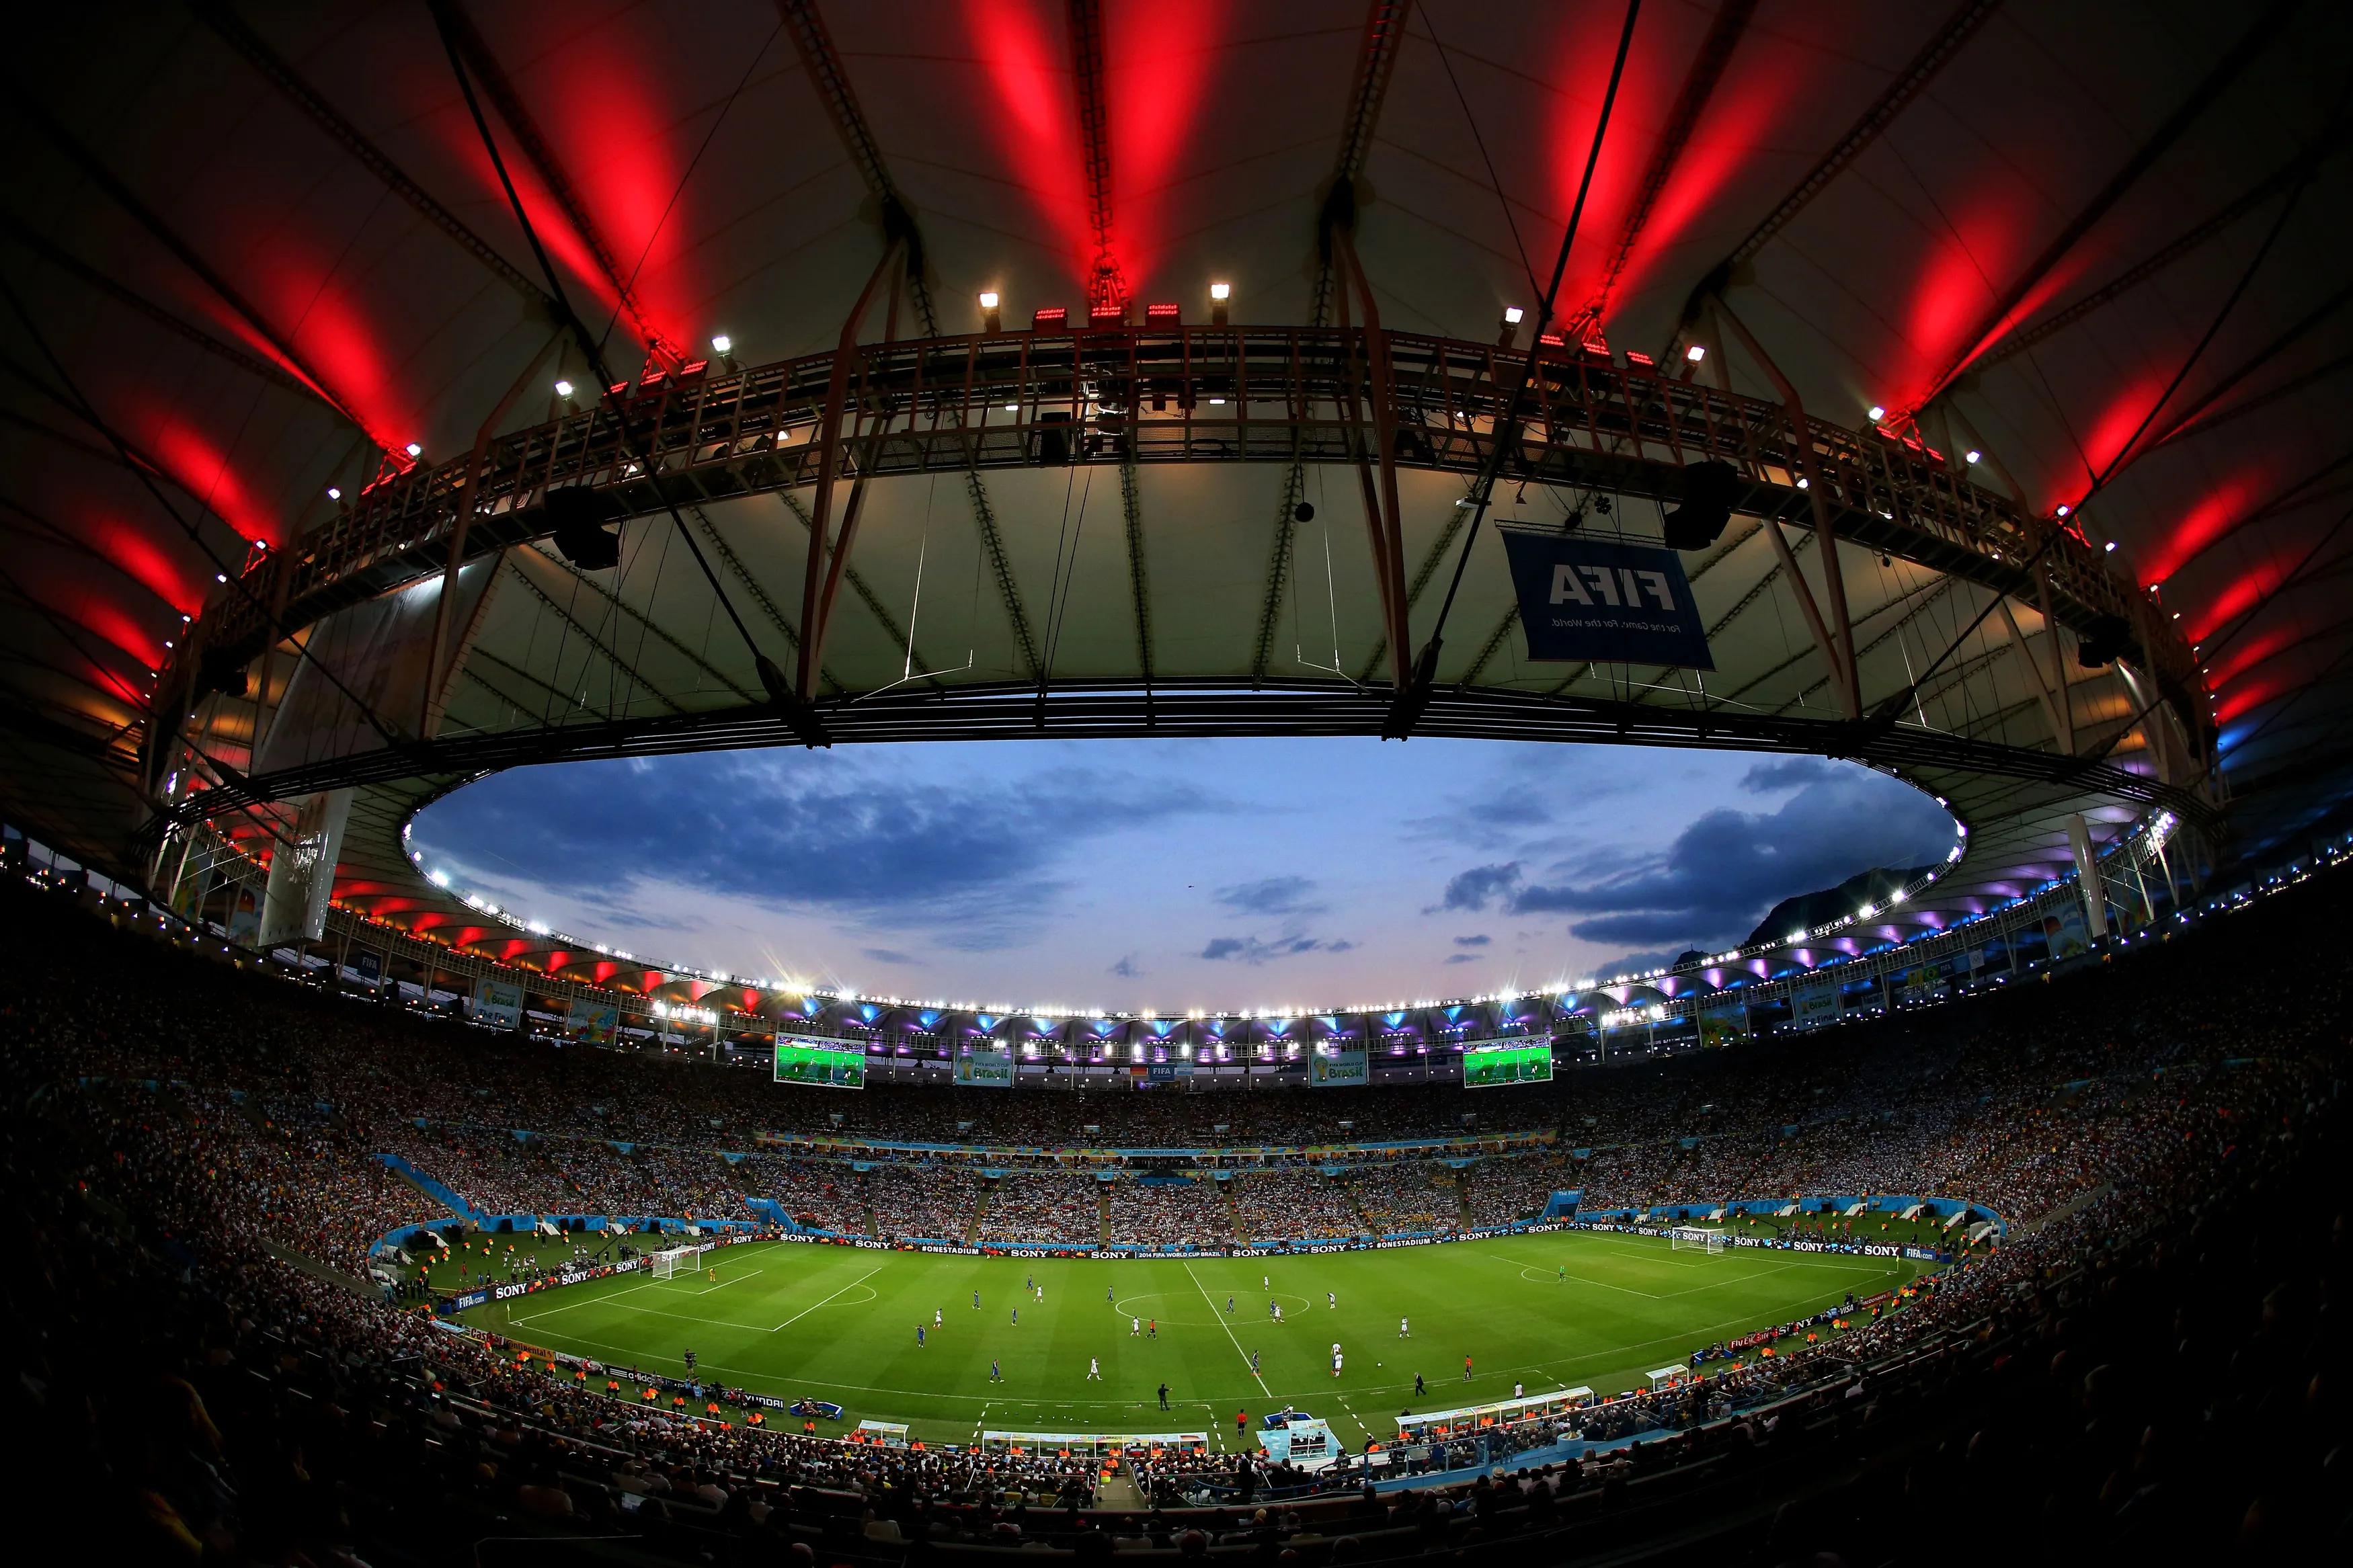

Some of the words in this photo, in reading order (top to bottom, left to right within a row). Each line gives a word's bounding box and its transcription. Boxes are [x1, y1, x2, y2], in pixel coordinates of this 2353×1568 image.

[362, 956, 377, 970] FIFA
[973, 1067, 1008, 1079] Brasil
[1328, 1067, 1363, 1078] Brasil
[1528, 1223, 1562, 1233] SONY
[1592, 1223, 1614, 1231] SONY
[1638, 1227, 1658, 1237] SONY
[733, 1235, 752, 1243] SONY
[781, 1233, 815, 1243] SONY
[1459, 1231, 1491, 1241] SONY
[1683, 1233, 1706, 1242] SONY
[856, 1240, 891, 1249] SONY
[1377, 1238, 1431, 1248] #ONESTADIUM
[1734, 1237, 1760, 1247] SONY
[1794, 1241, 1824, 1251] SONY
[700, 1242, 716, 1253] SONY
[922, 1245, 979, 1255] #ONESTADIUM
[1311, 1245, 1347, 1253] SONY
[1864, 1245, 1899, 1257] SONY
[662, 1253, 679, 1262] SONY
[1010, 1250, 1048, 1258] SONY
[1232, 1249, 1269, 1257] SONY
[616, 1260, 637, 1274] SONY
[561, 1271, 588, 1285] SONY
[496, 1283, 527, 1298] SONY
[1840, 1304, 1853, 1315] VISA
[1779, 1317, 1813, 1335] SNY
[738, 1393, 784, 1408] YUNDAI
